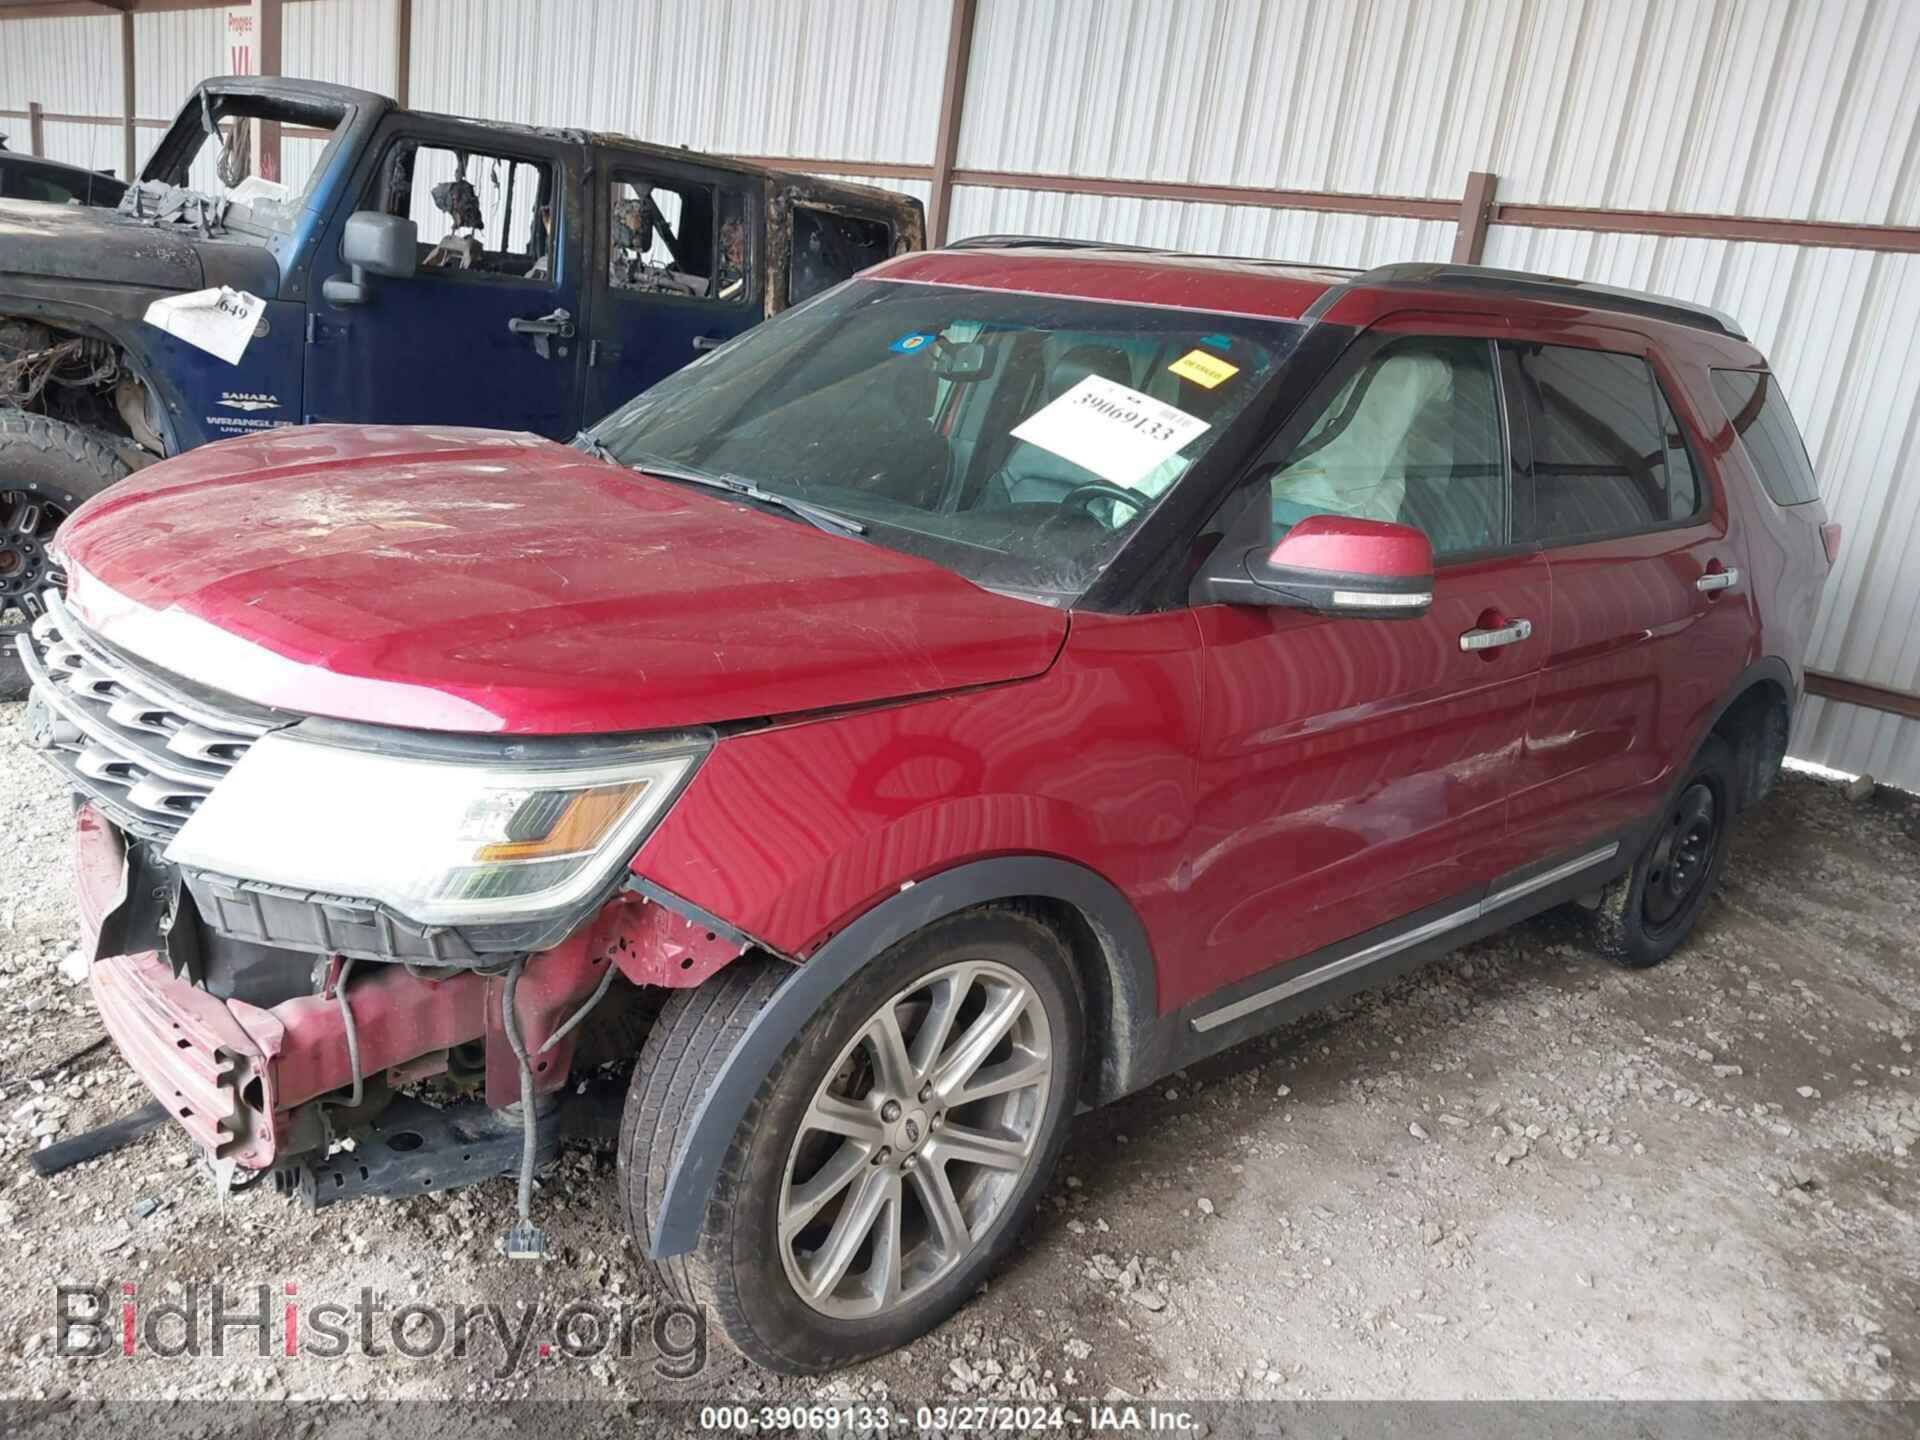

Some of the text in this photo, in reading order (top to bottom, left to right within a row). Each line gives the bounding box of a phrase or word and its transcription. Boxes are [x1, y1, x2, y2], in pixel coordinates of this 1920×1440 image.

[214, 299, 249, 320] 649
[222, 392, 278, 402] SAHARA
[206, 416, 294, 427] WRANGLER
[1073, 393, 1175, 441] 39069133
